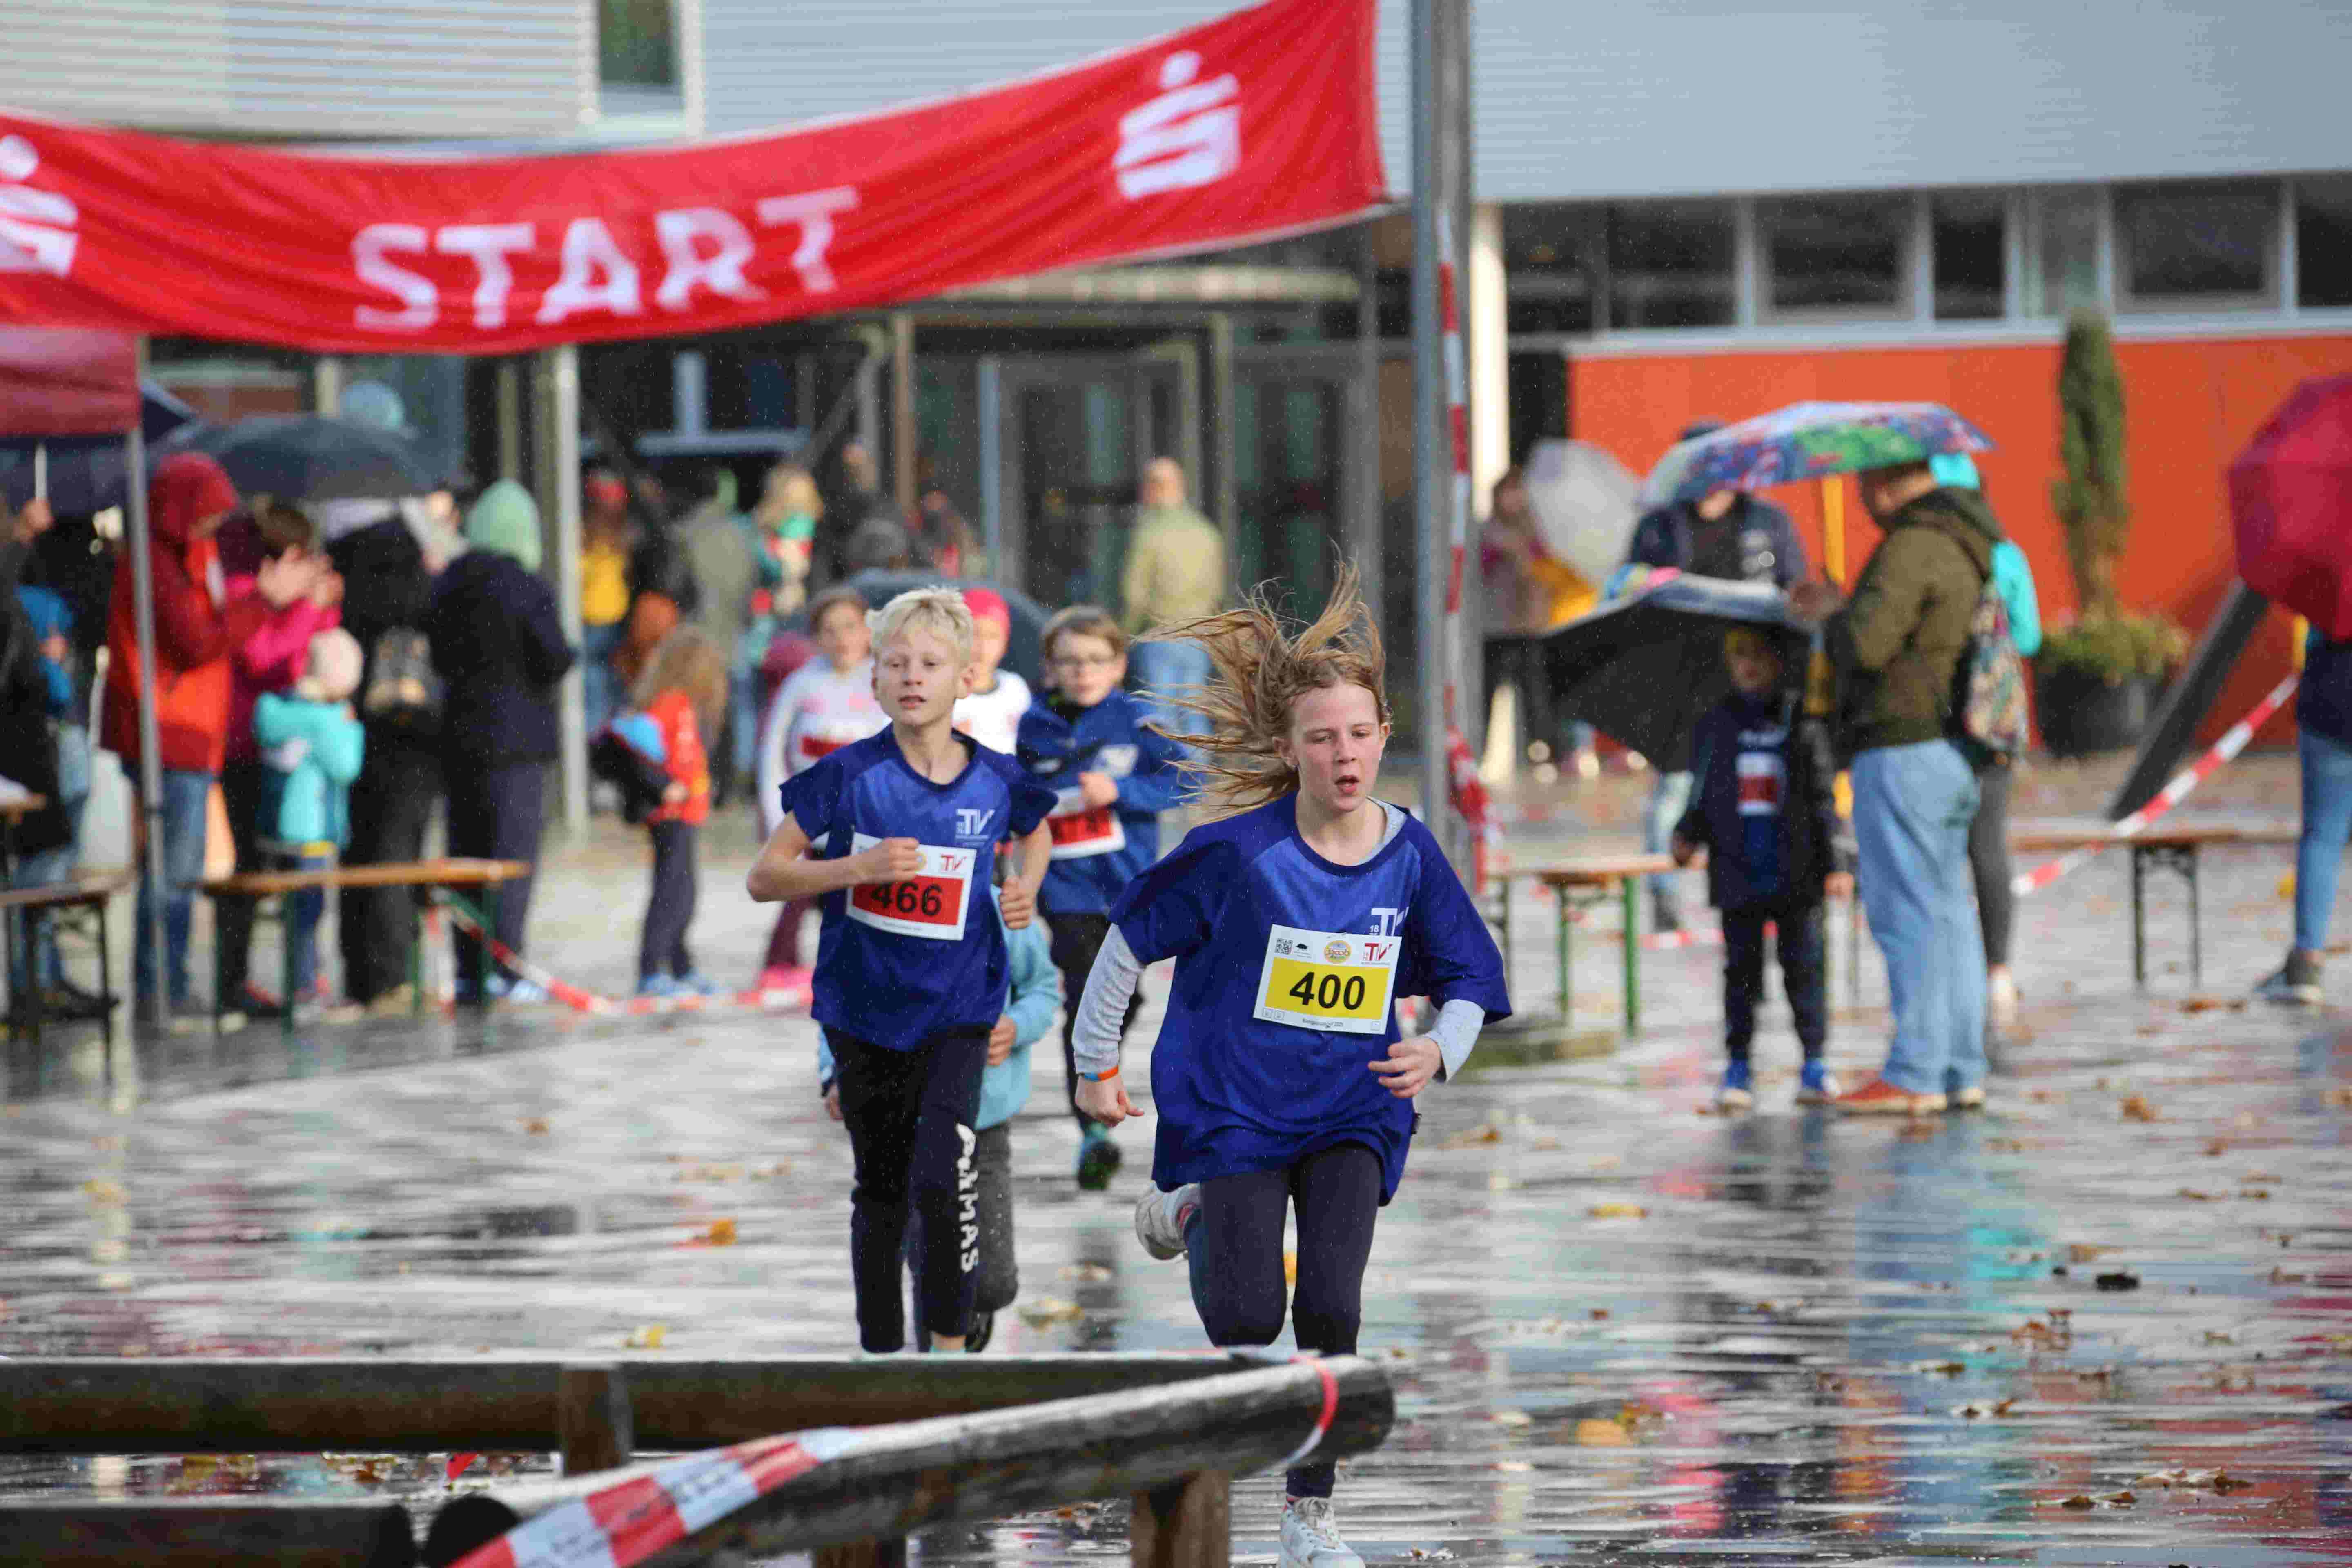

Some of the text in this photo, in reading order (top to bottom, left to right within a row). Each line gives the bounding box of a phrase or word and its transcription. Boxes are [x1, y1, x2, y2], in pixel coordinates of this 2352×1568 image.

[350, 185, 859, 330] START
[956, 808, 996, 836] TV
[940, 853, 968, 871] TV
[870, 881, 944, 917] 466
[1364, 942, 1393, 961] TV
[1289, 971, 1366, 1011] 400
